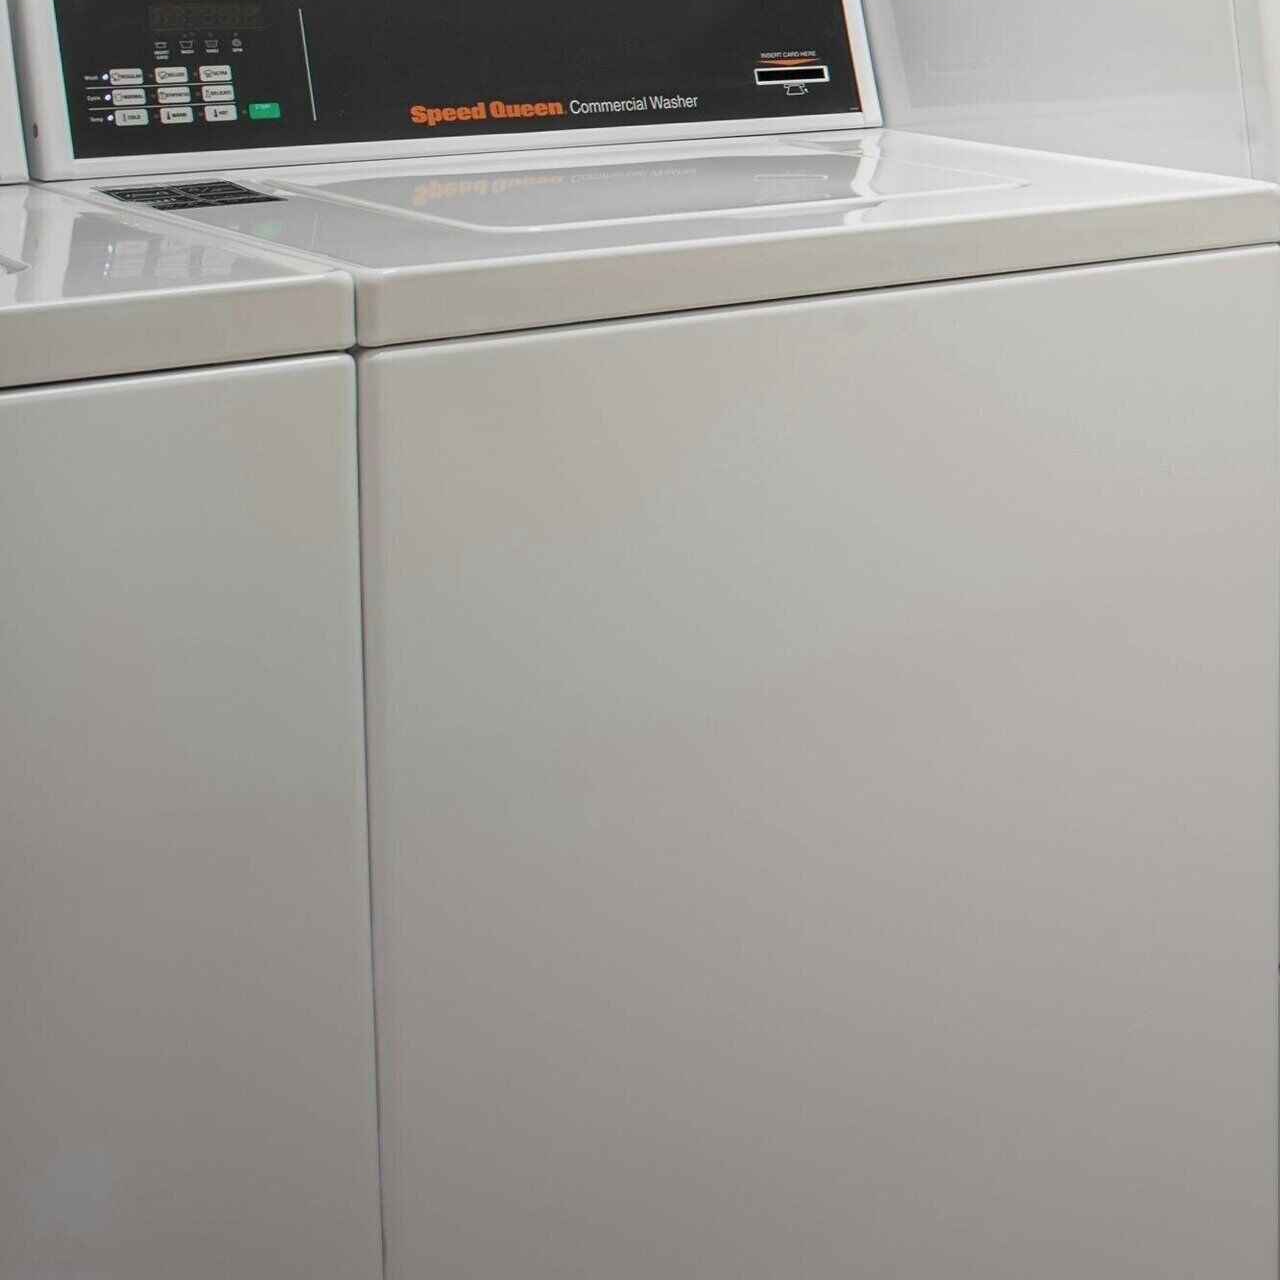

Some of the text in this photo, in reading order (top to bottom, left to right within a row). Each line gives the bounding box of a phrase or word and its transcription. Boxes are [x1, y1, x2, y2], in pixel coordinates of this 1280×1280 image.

[761, 51, 781, 59] INSERT
[410, 94, 698, 126] Speed Queen Commercial Washer
